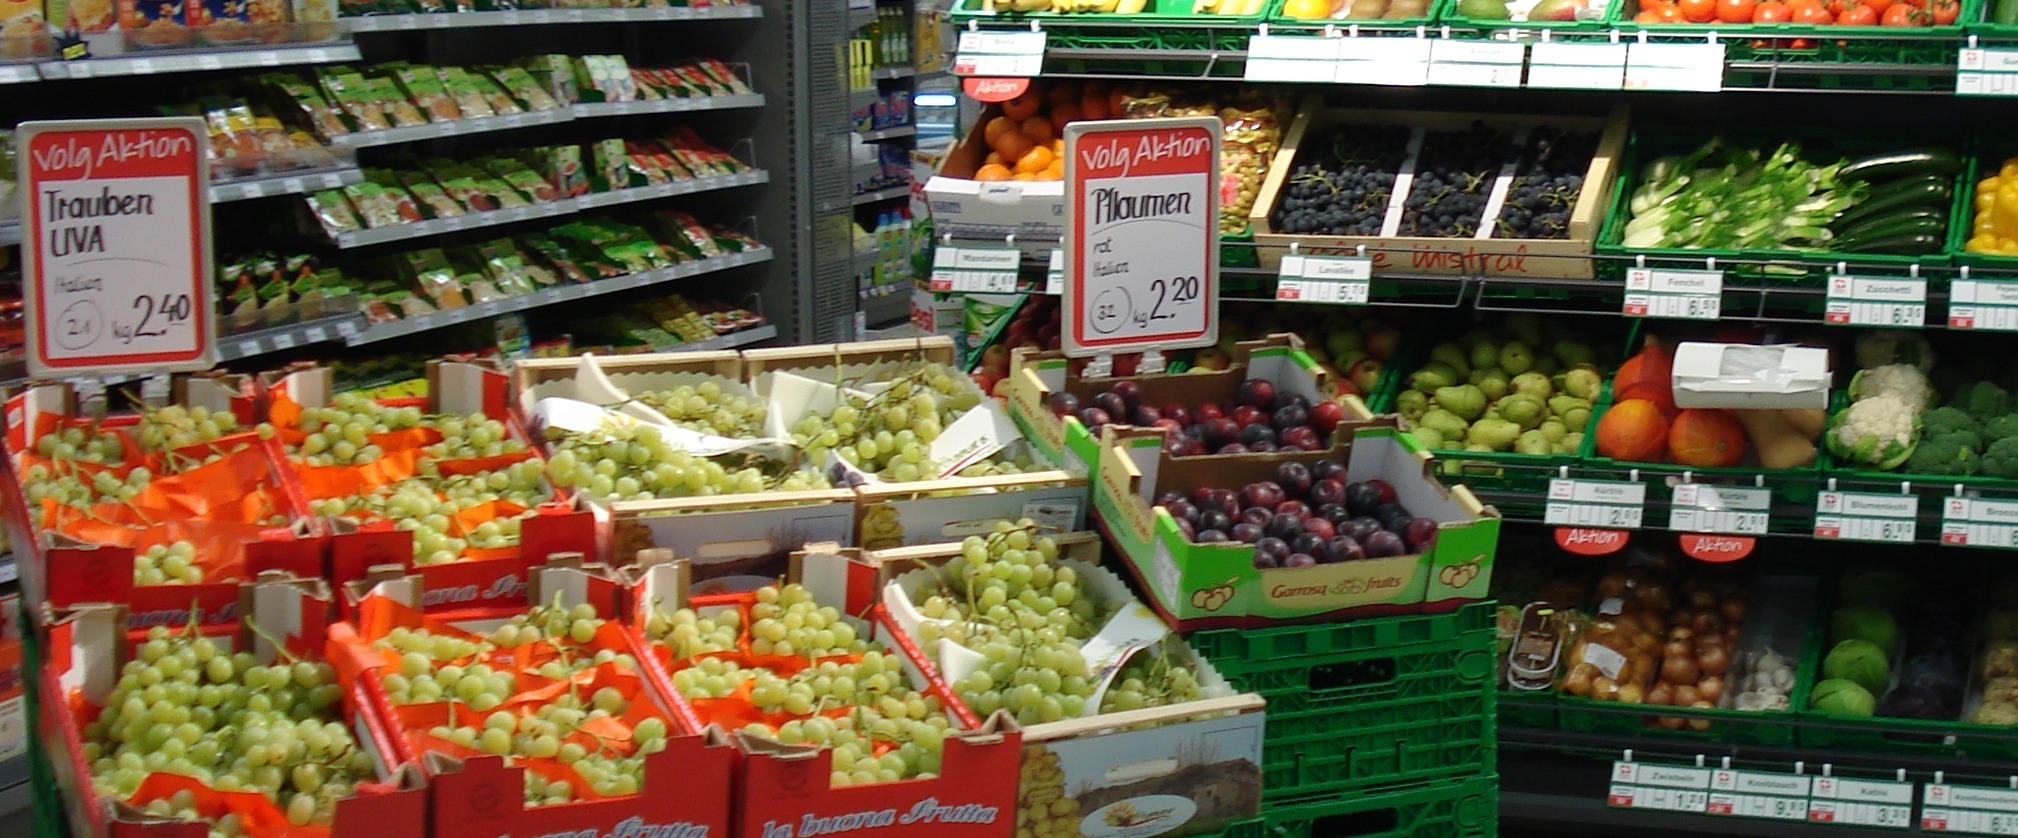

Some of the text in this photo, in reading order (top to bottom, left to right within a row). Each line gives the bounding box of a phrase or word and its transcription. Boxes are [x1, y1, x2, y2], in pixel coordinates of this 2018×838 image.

[96, 131, 192, 168] Aktion
[1132, 133, 1212, 167] Aktion
[45, 186, 153, 222] Trauben
[1091, 187, 1191, 226] Pflaumen
[51, 225, 105, 257] UVA
[112, 320, 133, 345] kg
[1132, 312, 1148, 328] kg
[1564, 529, 1620, 545] Aktion
[1692, 537, 1743, 553] Aktion
[1363, 577, 1402, 593] fruits
[797, 809, 897, 837] buona
[900, 797, 999, 824] Frutta
